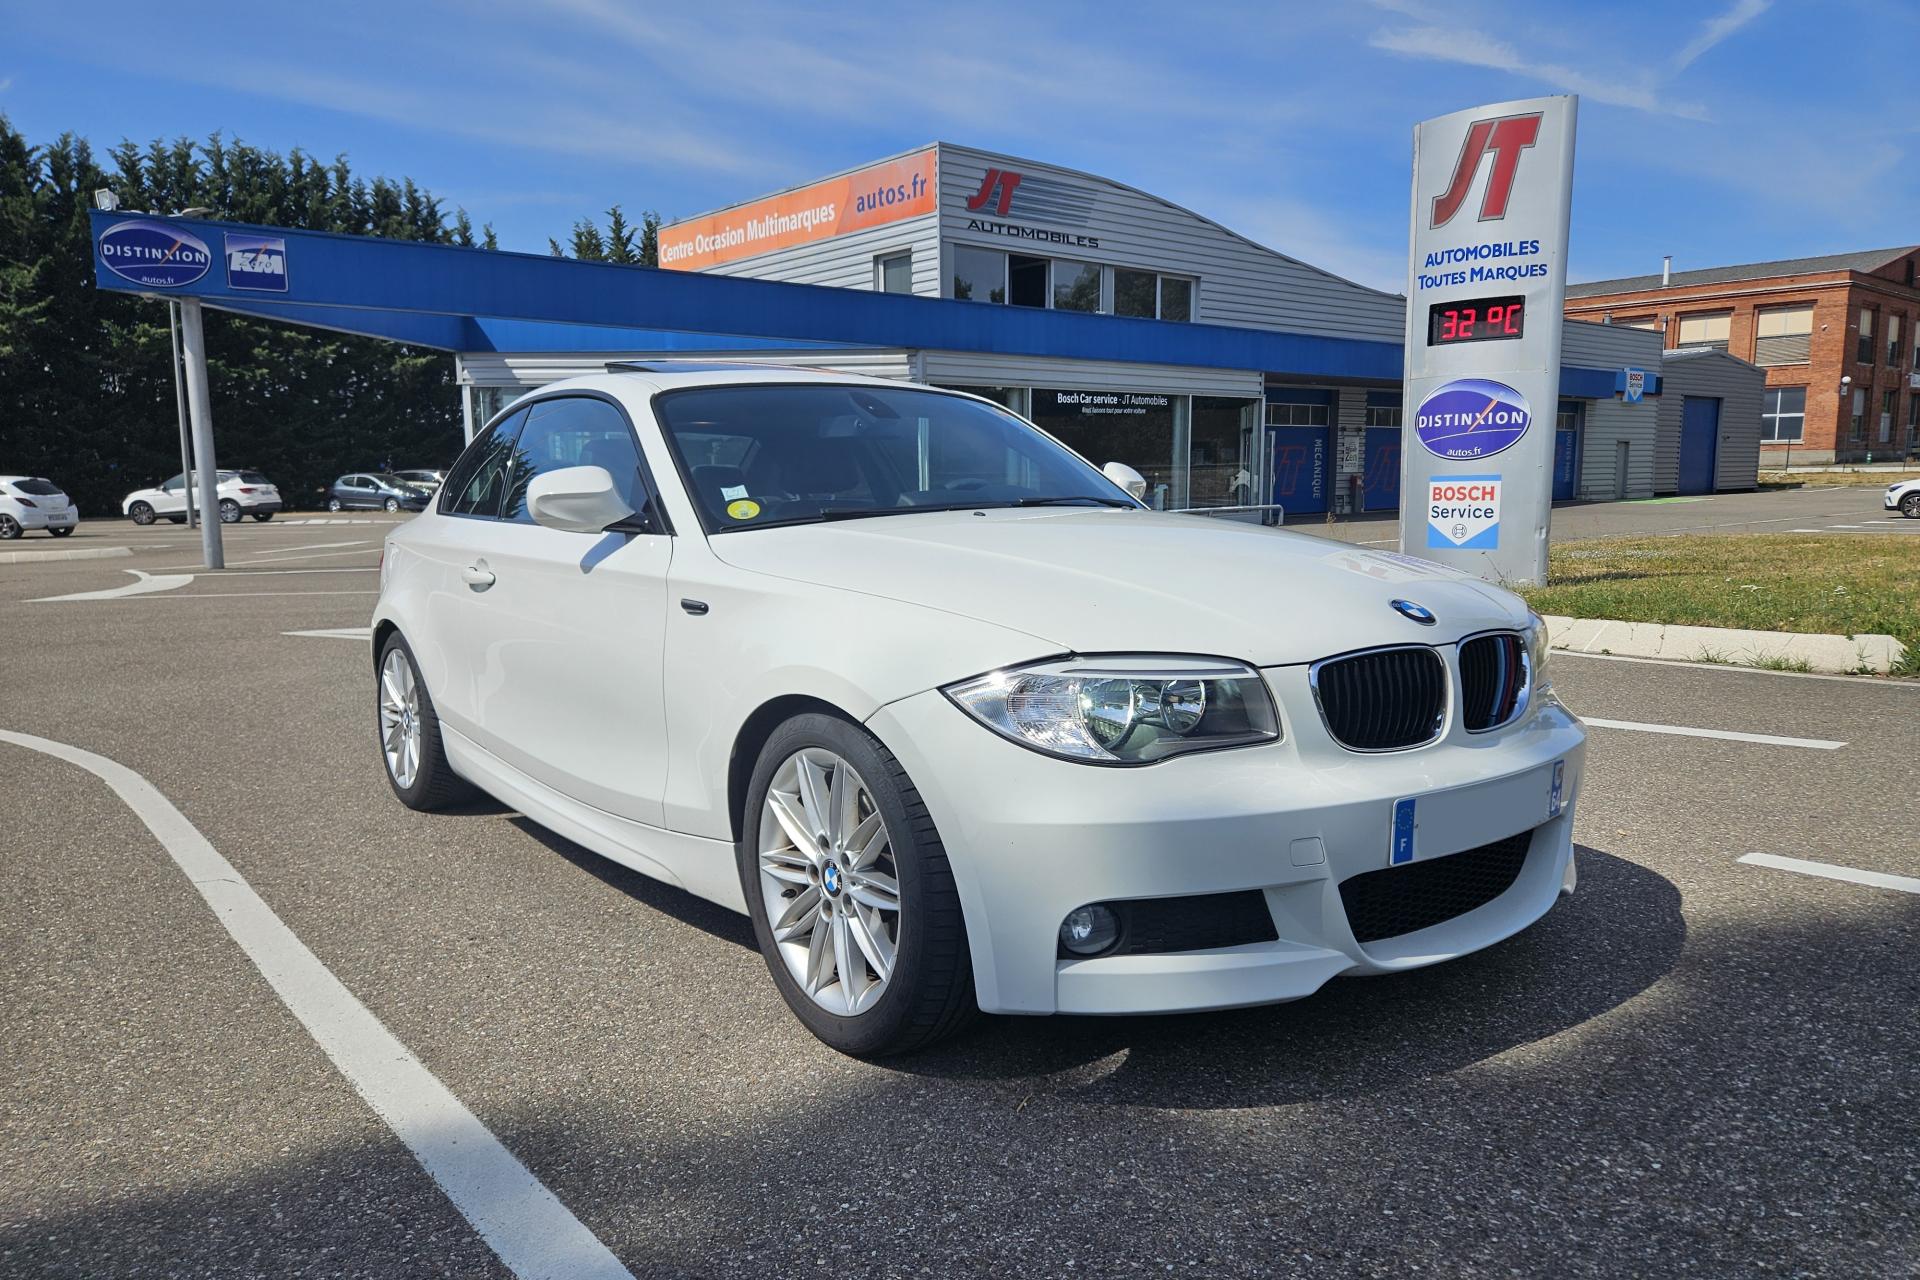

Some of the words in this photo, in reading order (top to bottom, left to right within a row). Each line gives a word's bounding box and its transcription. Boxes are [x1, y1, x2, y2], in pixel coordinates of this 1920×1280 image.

[1430, 111, 1544, 230] JT
[856, 173, 927, 213] autos.fr
[966, 168, 1023, 217] JT
[660, 241, 694, 264] Centre
[695, 227, 744, 255] Occasion
[747, 202, 835, 242] Multimarques
[967, 219, 1099, 249] AUTOMOBILES
[103, 243, 206, 264] DISTINXION
[1425, 239, 1540, 268] AUTOMOBILES
[141, 275, 175, 285] autos.fr
[1418, 271, 1466, 290] TOUTES
[1470, 263, 1548, 283] MARQUES
[1441, 309, 1477, 339] 32
[1629, 373, 1643, 381] BOSCH
[1057, 393, 1079, 404] Bosch
[1080, 393, 1093, 404] Car
[1093, 394, 1118, 404] service
[1122, 394, 1130, 405] JT
[1130, 395, 1168, 406] Automobiles
[1418, 410, 1524, 429] DISTINXION
[1447, 446, 1482, 457] autos.fr
[1312, 439, 1323, 499] MECANIQUE
[1432, 486, 1495, 502] BOSCH
[1431, 505, 1494, 519] Service
[1400, 838, 1407, 852] F
